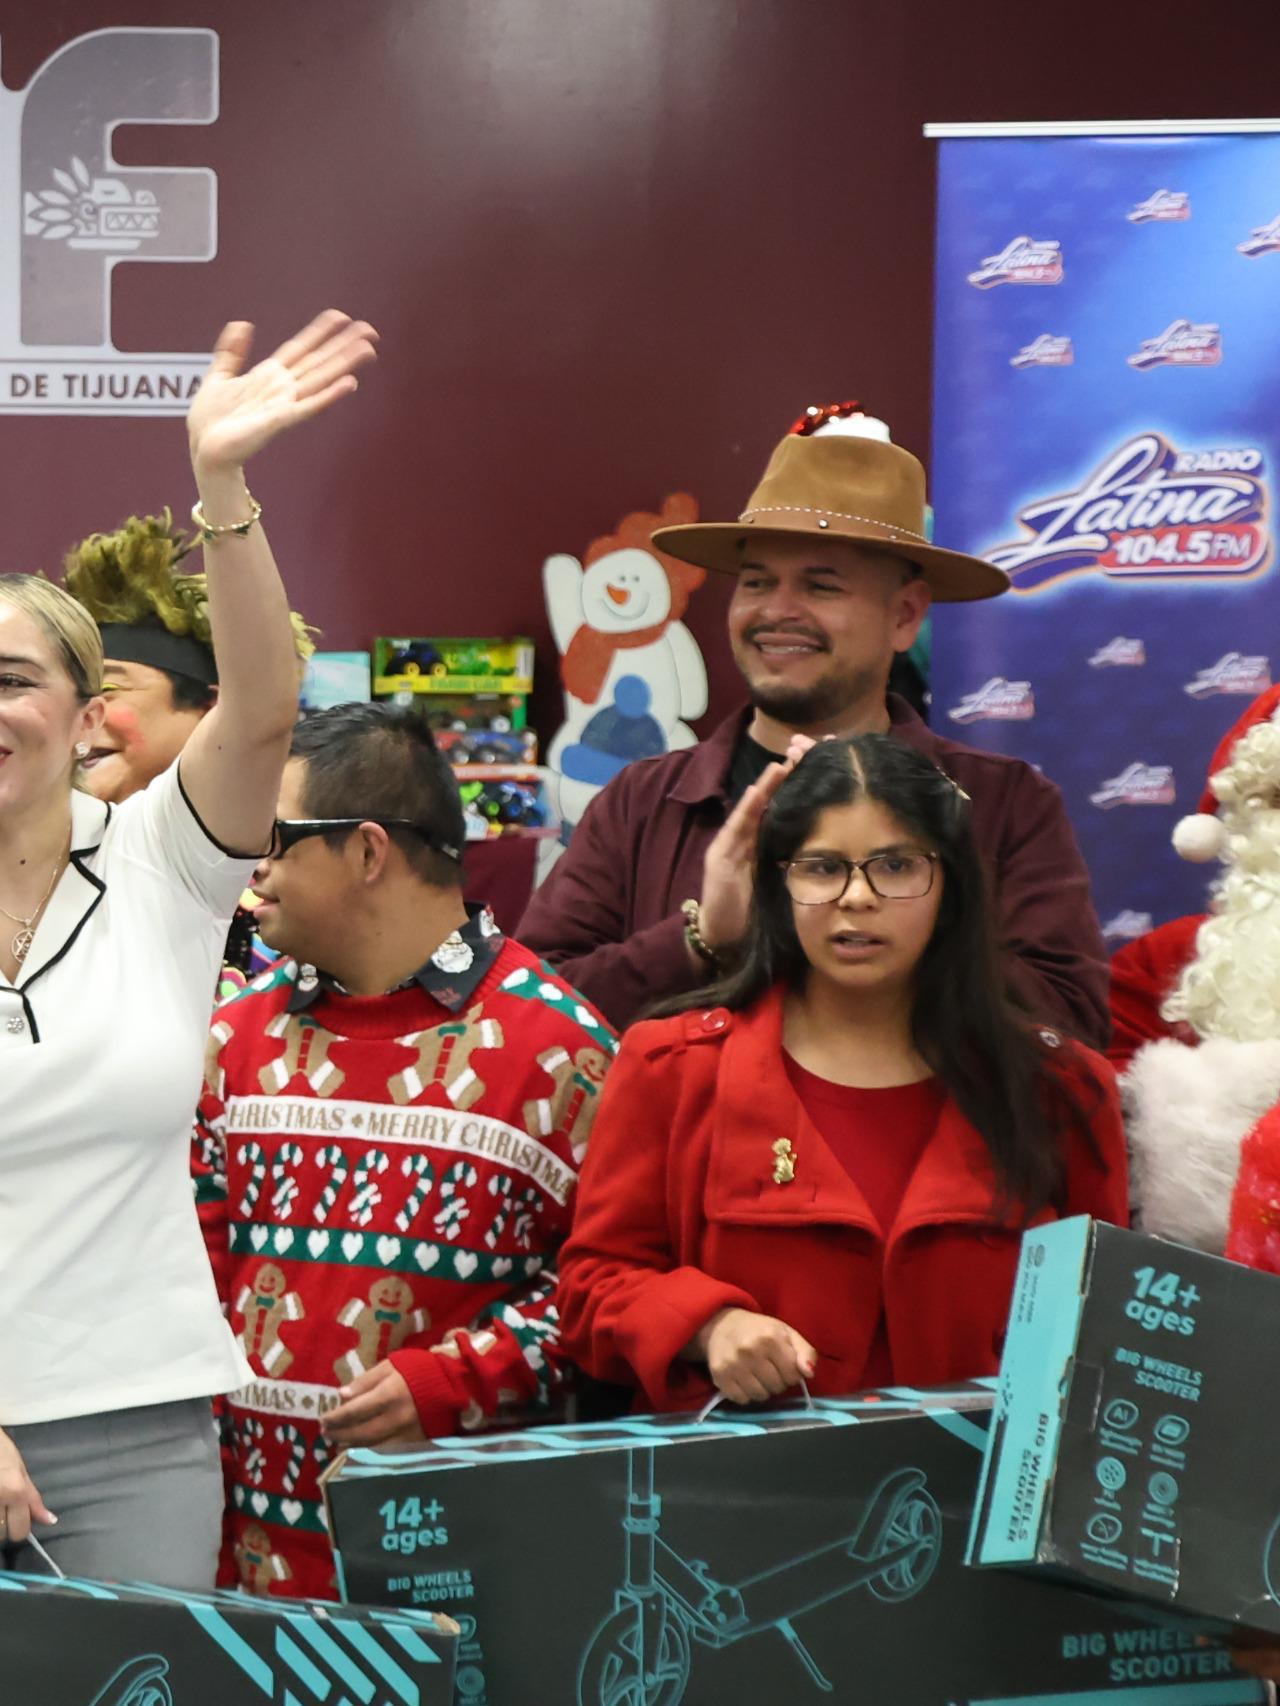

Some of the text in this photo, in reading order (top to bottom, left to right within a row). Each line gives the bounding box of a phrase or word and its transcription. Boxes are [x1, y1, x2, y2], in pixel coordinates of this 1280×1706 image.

[11, 373, 50, 398] DE
[63, 373, 204, 399] TIJUANA
[1174, 449, 1262, 471] RADIO
[982, 434, 1256, 572] Latina
[228, 1102, 577, 1200] HRISTMAS MERRY CHRISTMA
[1133, 1266, 1201, 1308] 14+
[1124, 1299, 1196, 1336] ages
[1114, 1347, 1203, 1386] BIG WHEELS
[1134, 1370, 1201, 1402] SCOOTER
[1018, 1412, 1049, 1541] BIG WHEELS
[1007, 1448, 1032, 1543] SCOOTER
[379, 1497, 444, 1530] 14+
[381, 1526, 449, 1555] ages
[387, 1570, 472, 1592] BIG WHEELS
[412, 1584, 475, 1603] SCOOTER
[1061, 1633, 1107, 1659] BIG
[1109, 1652, 1233, 1682] SCOOTER
